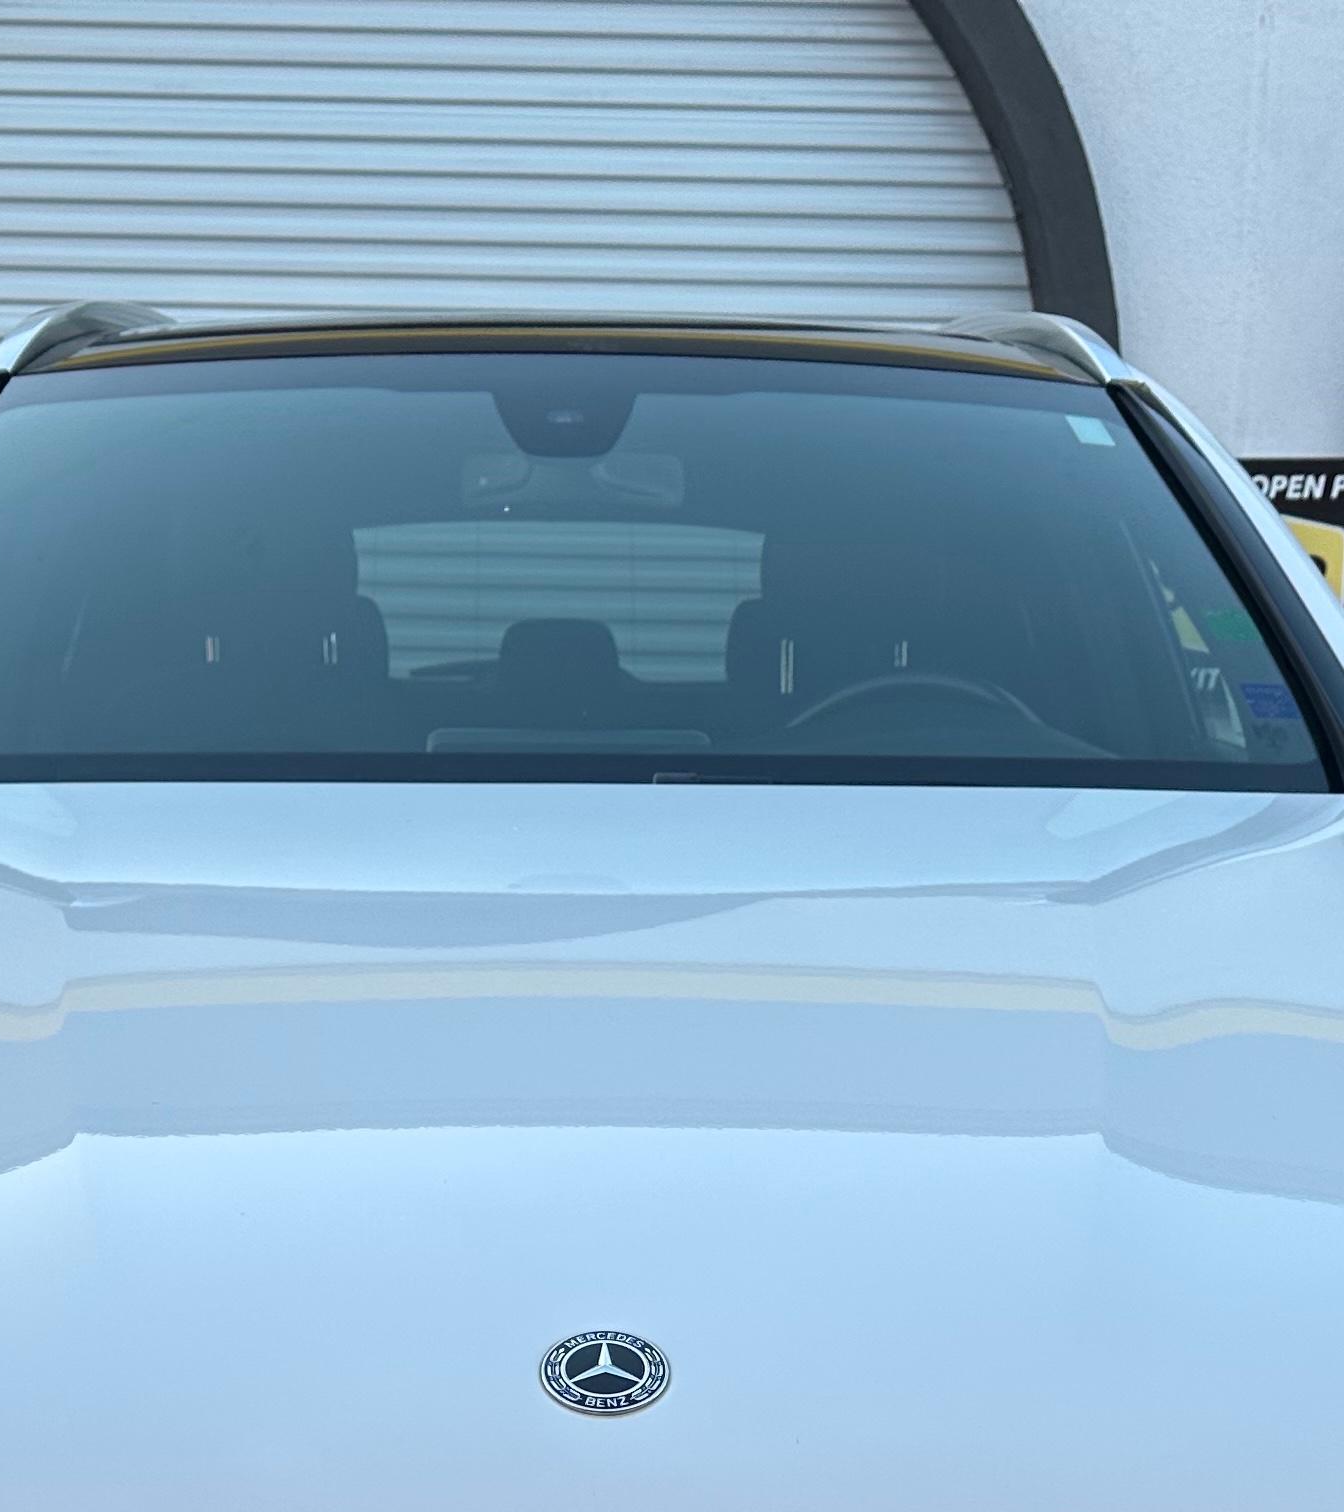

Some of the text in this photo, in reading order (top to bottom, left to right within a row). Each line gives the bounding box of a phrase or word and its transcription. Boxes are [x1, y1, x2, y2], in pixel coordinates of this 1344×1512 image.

[1252, 473, 1327, 499] OPEN
[564, 1331, 646, 1349] MERCEDES
[584, 1396, 630, 1408] BENZ
